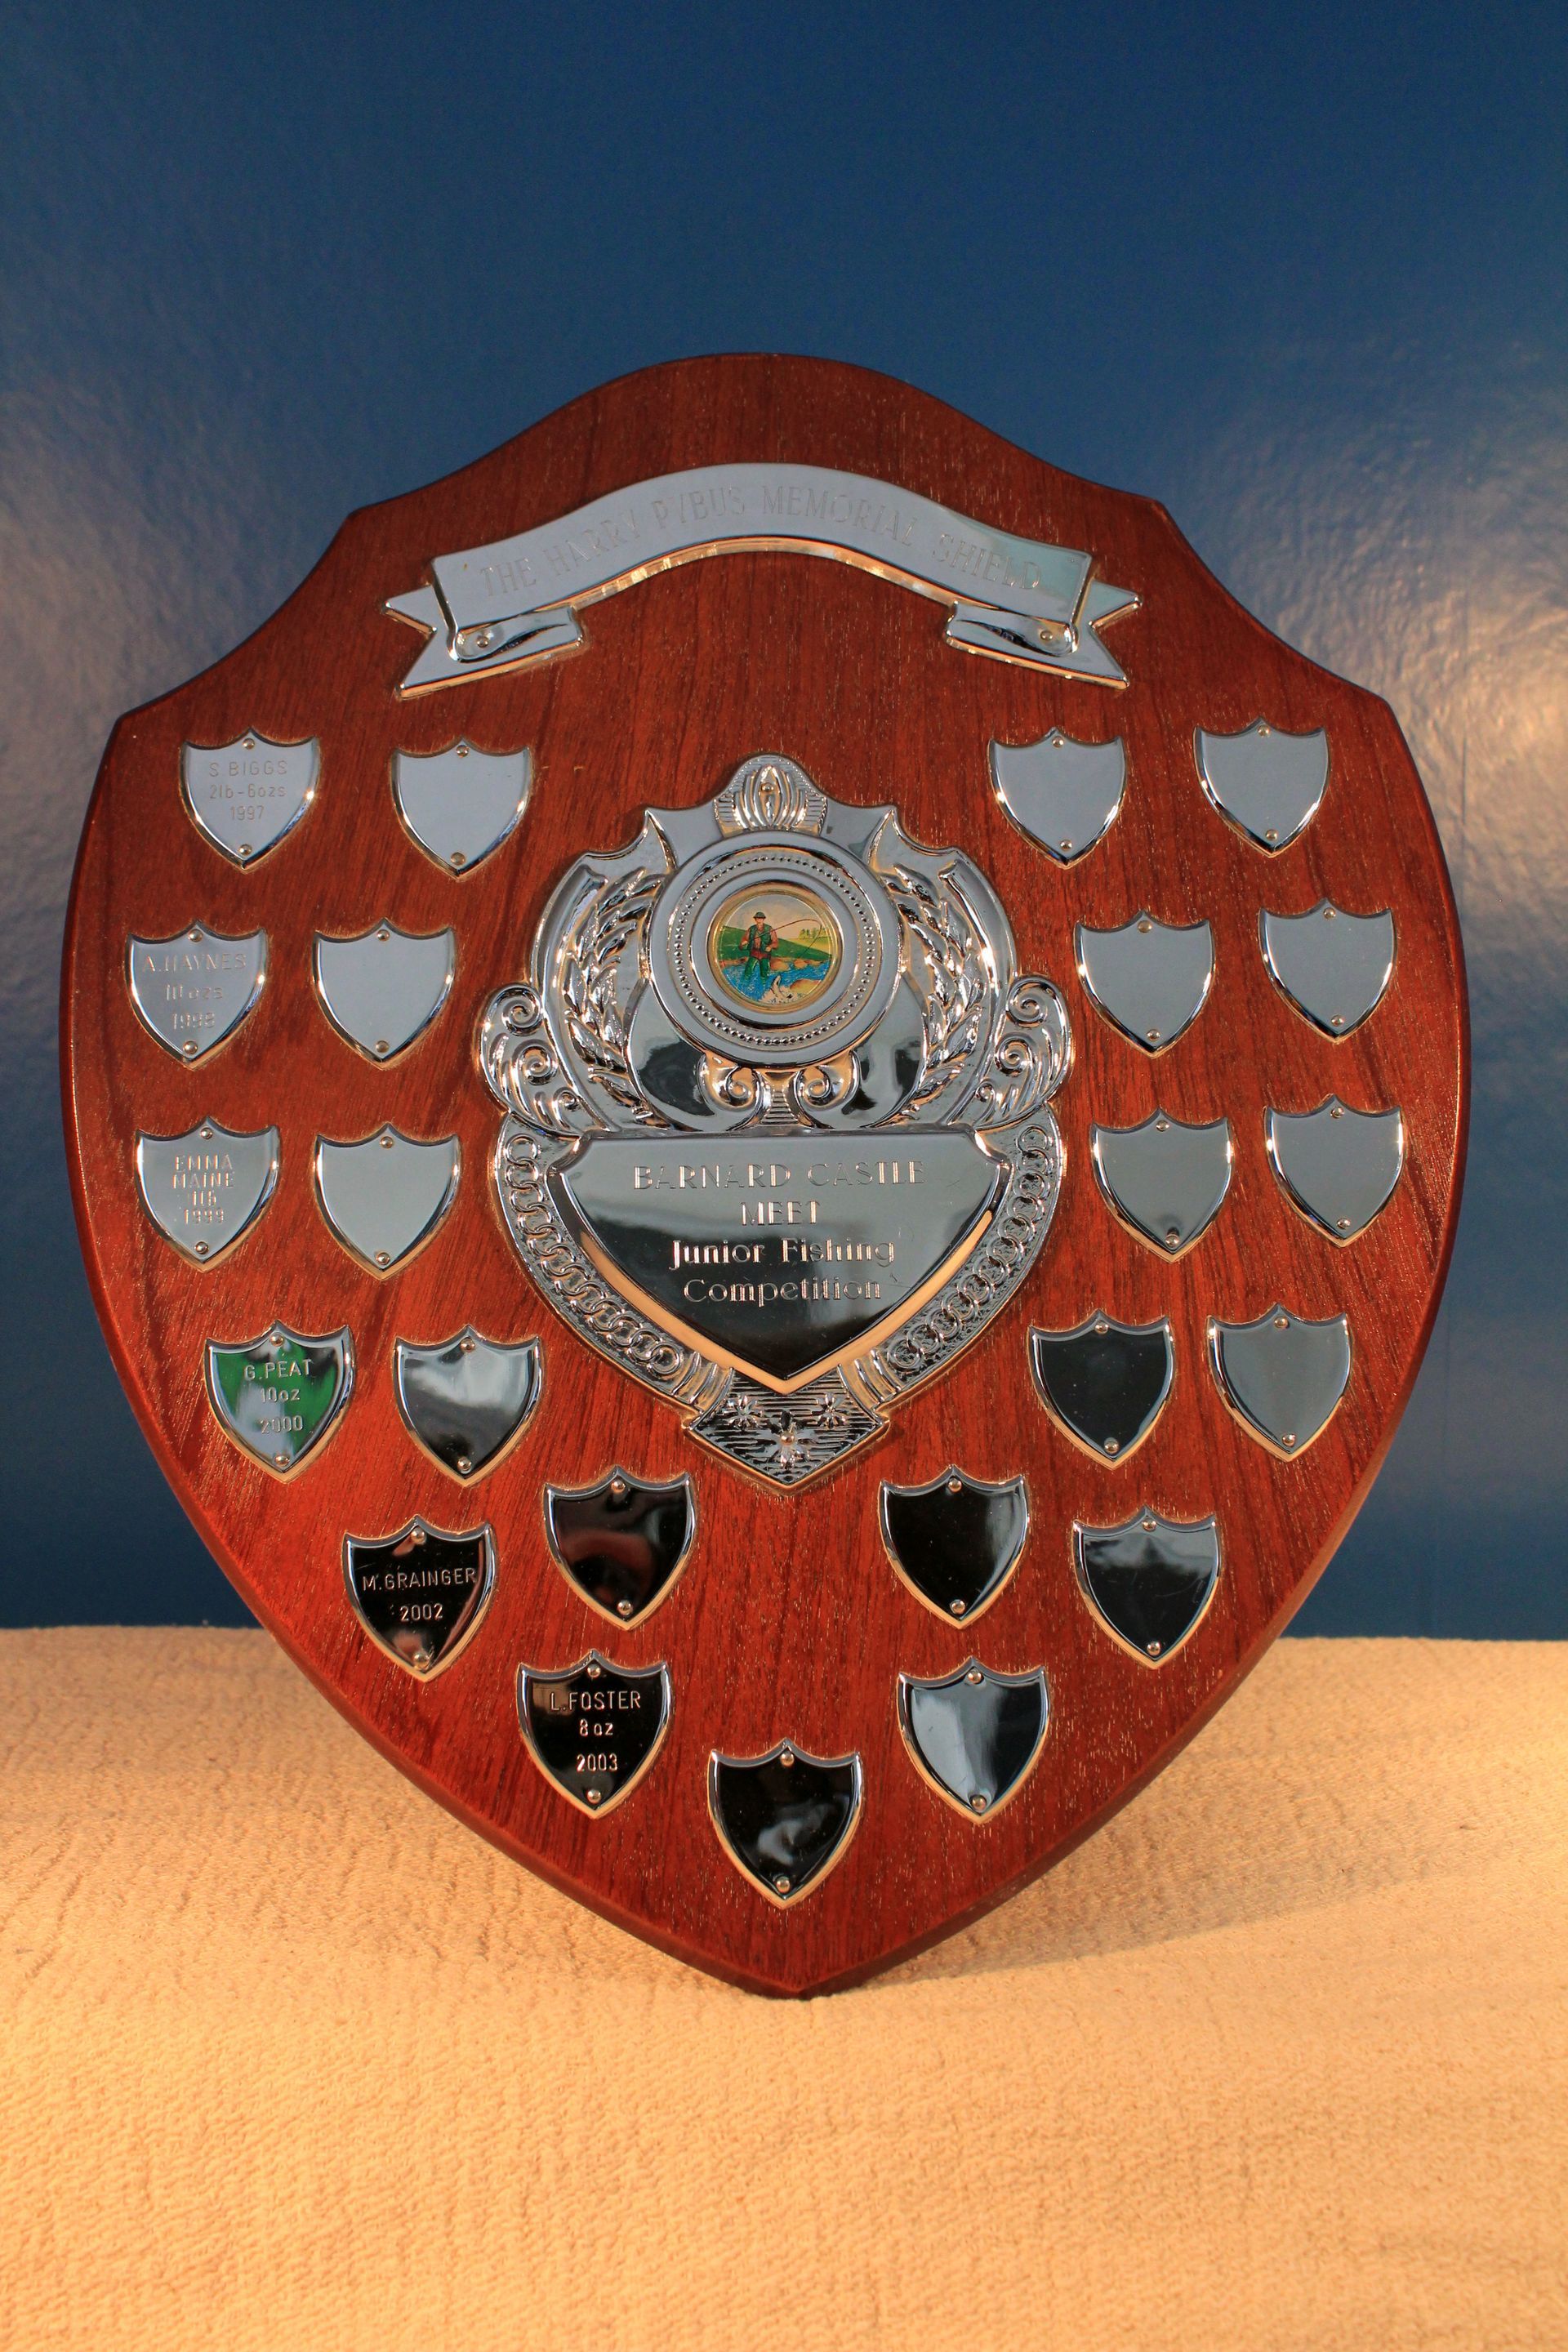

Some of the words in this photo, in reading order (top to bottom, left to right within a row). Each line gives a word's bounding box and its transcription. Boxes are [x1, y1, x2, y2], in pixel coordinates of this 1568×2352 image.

[479, 559, 537, 597] THE
[543, 514, 642, 577] HARRY
[654, 486, 746, 530] PYBUS
[763, 486, 918, 546] MEMORIAL
[931, 533, 1041, 590] SHIELD
[209, 762, 220, 777] S
[229, 760, 287, 777] BIGGS
[230, 805, 265, 821] 1997
[172, 1013, 216, 1030] 1998
[175, 1154, 234, 1173] EMMA
[172, 1173, 235, 1189] MAINE
[634, 1163, 791, 1190] BARNARD
[807, 1160, 925, 1187] CASTLE
[184, 1209, 224, 1225] 1999
[740, 1200, 821, 1227] MEET
[670, 1239, 764, 1270] Junior
[781, 1237, 895, 1266] Fishing
[684, 1276, 881, 1307] Competition
[259, 1414, 304, 1434] 2000
[399, 1603, 443, 1622] 2002
[576, 1753, 619, 1772] 2003
